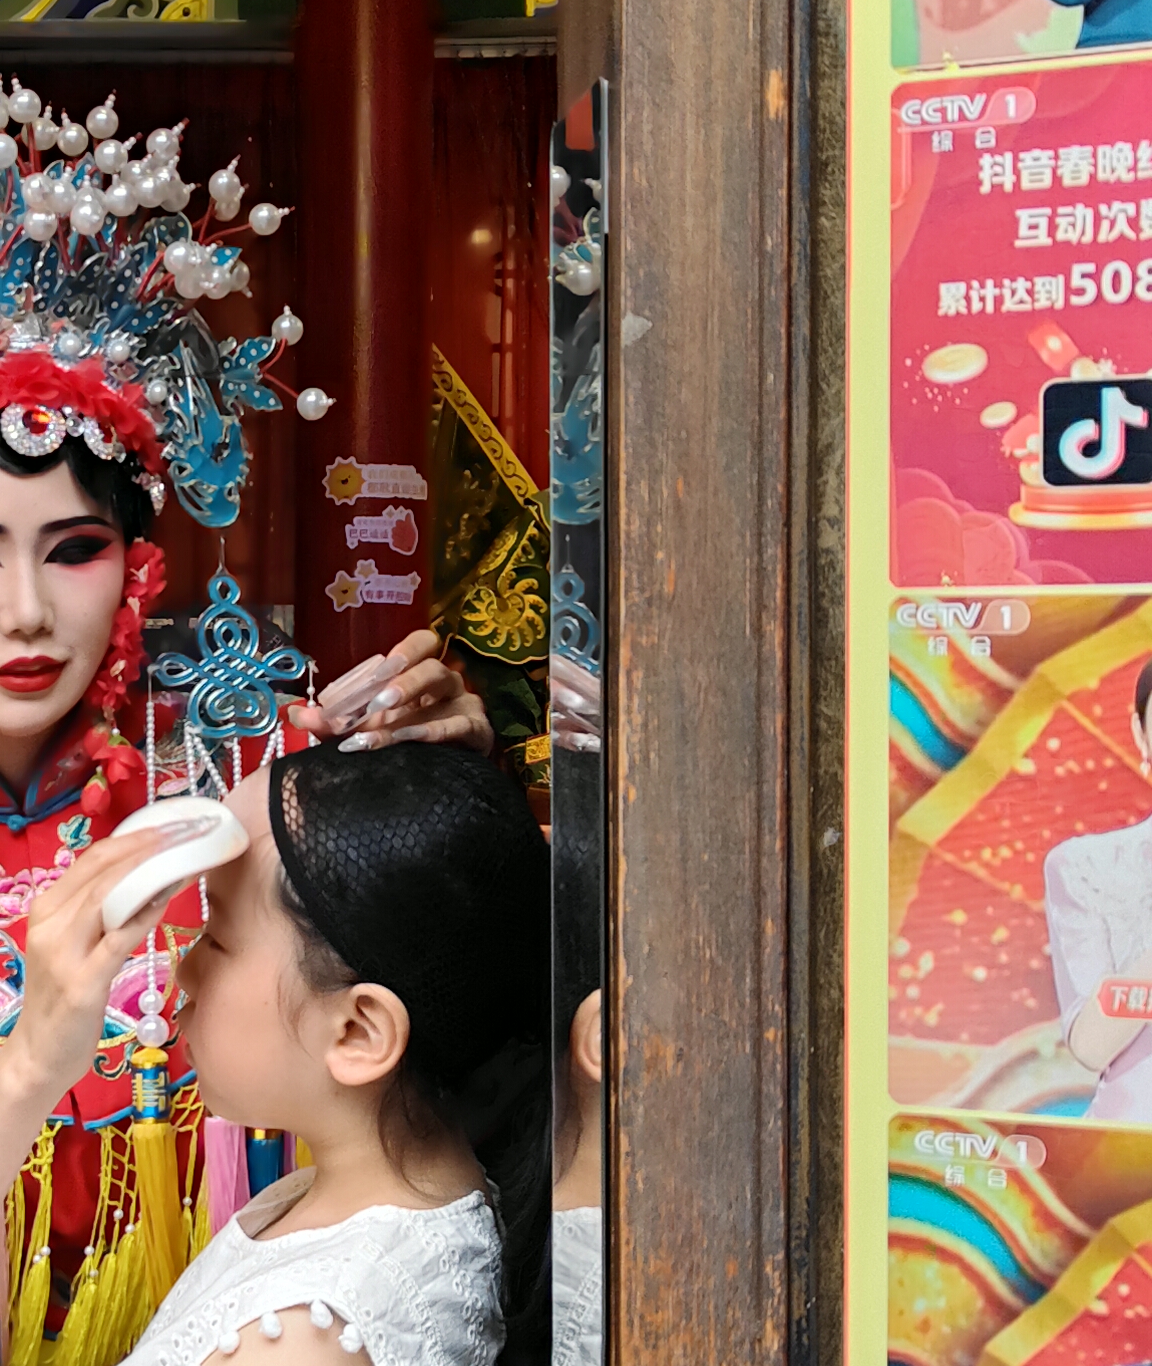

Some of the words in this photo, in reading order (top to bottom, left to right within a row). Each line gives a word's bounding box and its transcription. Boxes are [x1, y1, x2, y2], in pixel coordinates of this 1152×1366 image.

[900, 93, 987, 125] CCTV
[1005, 93, 1016, 119] 1
[896, 602, 982, 629] CCTV
[1000, 605, 1011, 630] 1
[914, 1130, 997, 1160] CCTV
[1016, 1140, 1028, 1166] 1
[945, 1164, 1007, 1190] 综合
